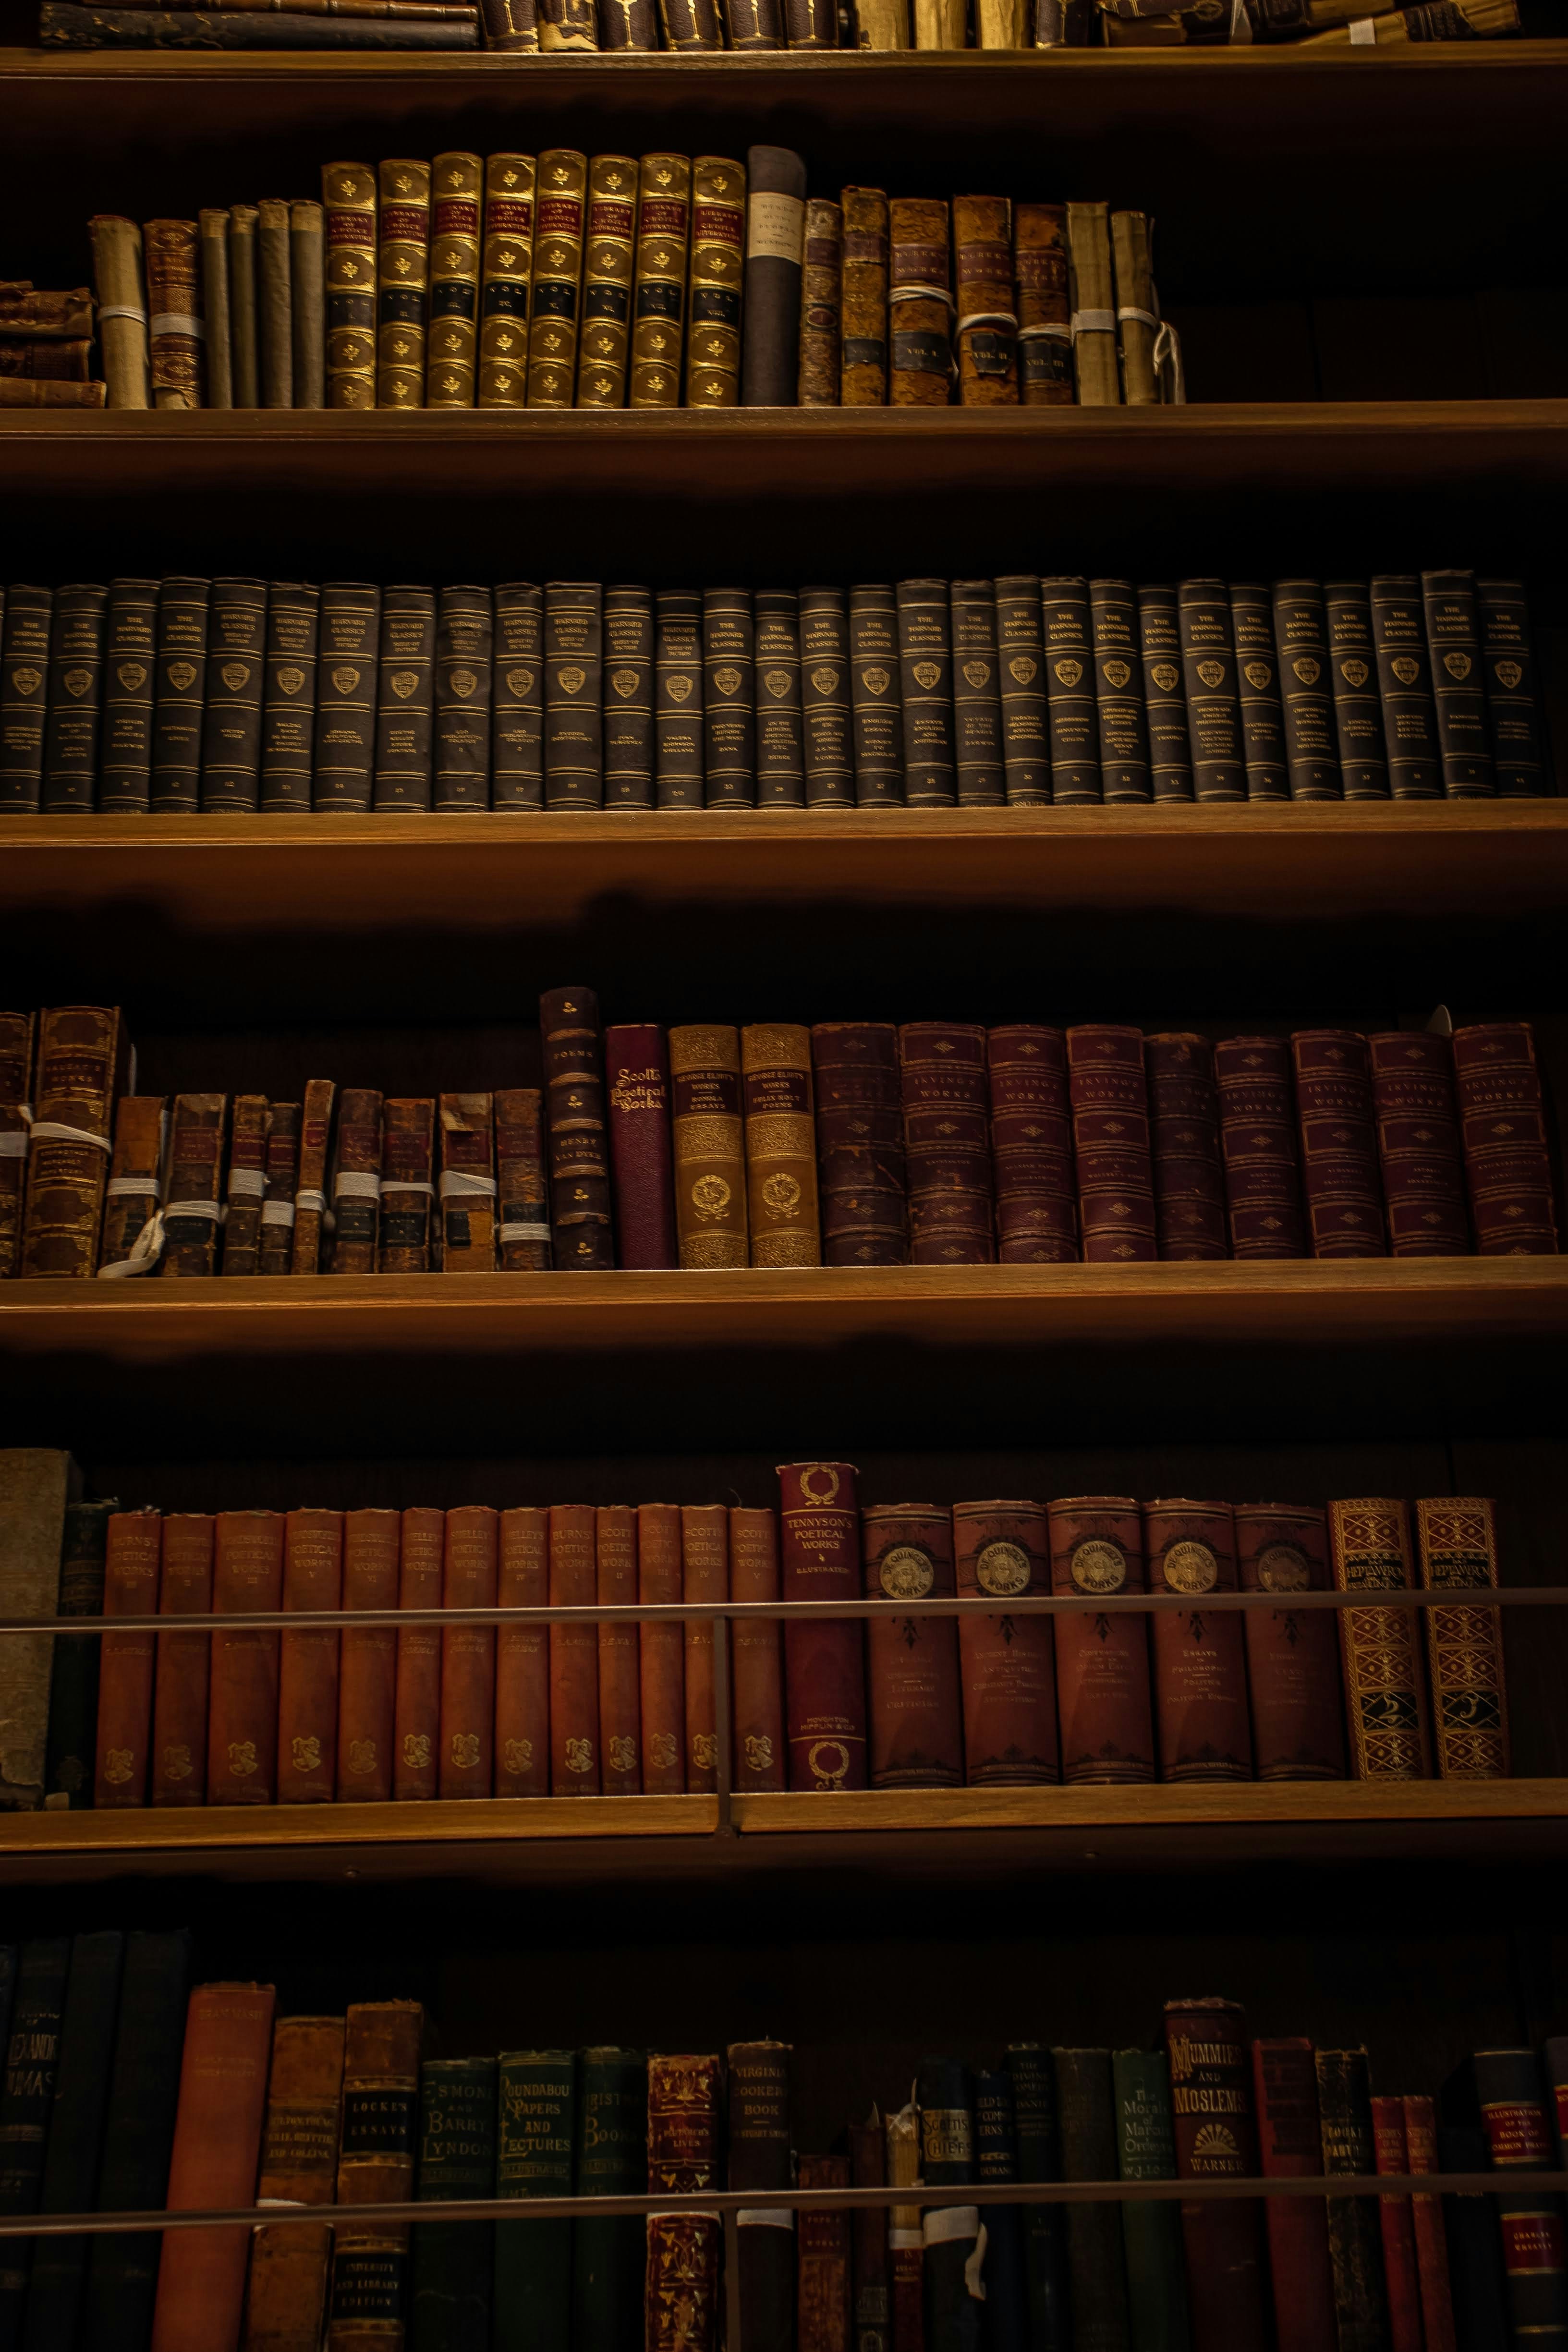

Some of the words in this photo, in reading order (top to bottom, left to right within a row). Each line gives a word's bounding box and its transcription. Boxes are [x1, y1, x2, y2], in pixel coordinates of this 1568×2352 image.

[788, 1517, 853, 1529] TENNYSON'S
[795, 1529, 846, 1540] POETICAL
[802, 1540, 841, 1550] WORKS
[1075, 1556, 1085, 1568] DE
[883, 1564, 892, 1575] DE
[1083, 1574, 1119, 1588] WORKS
[891, 1581, 926, 1596] WORKS
[1379, 1691, 1402, 1724] 2
[1199, 2071, 1222, 2082] AND
[1173, 2086, 1247, 2113] MOSLEMS
[353, 2101, 408, 2112] LOCKE'S
[744, 2105, 779, 2116] BOOK
[428, 2110, 486, 2134] BARRY
[523, 2120, 552, 2134] AND
[351, 2125, 407, 2136] ESSAYS
[1499, 2130, 1525, 2140] BOOK
[423, 2137, 492, 2161] LYNDON
[672, 2139, 702, 2148] LIVES
[1190, 2158, 1245, 2171] WARNER
